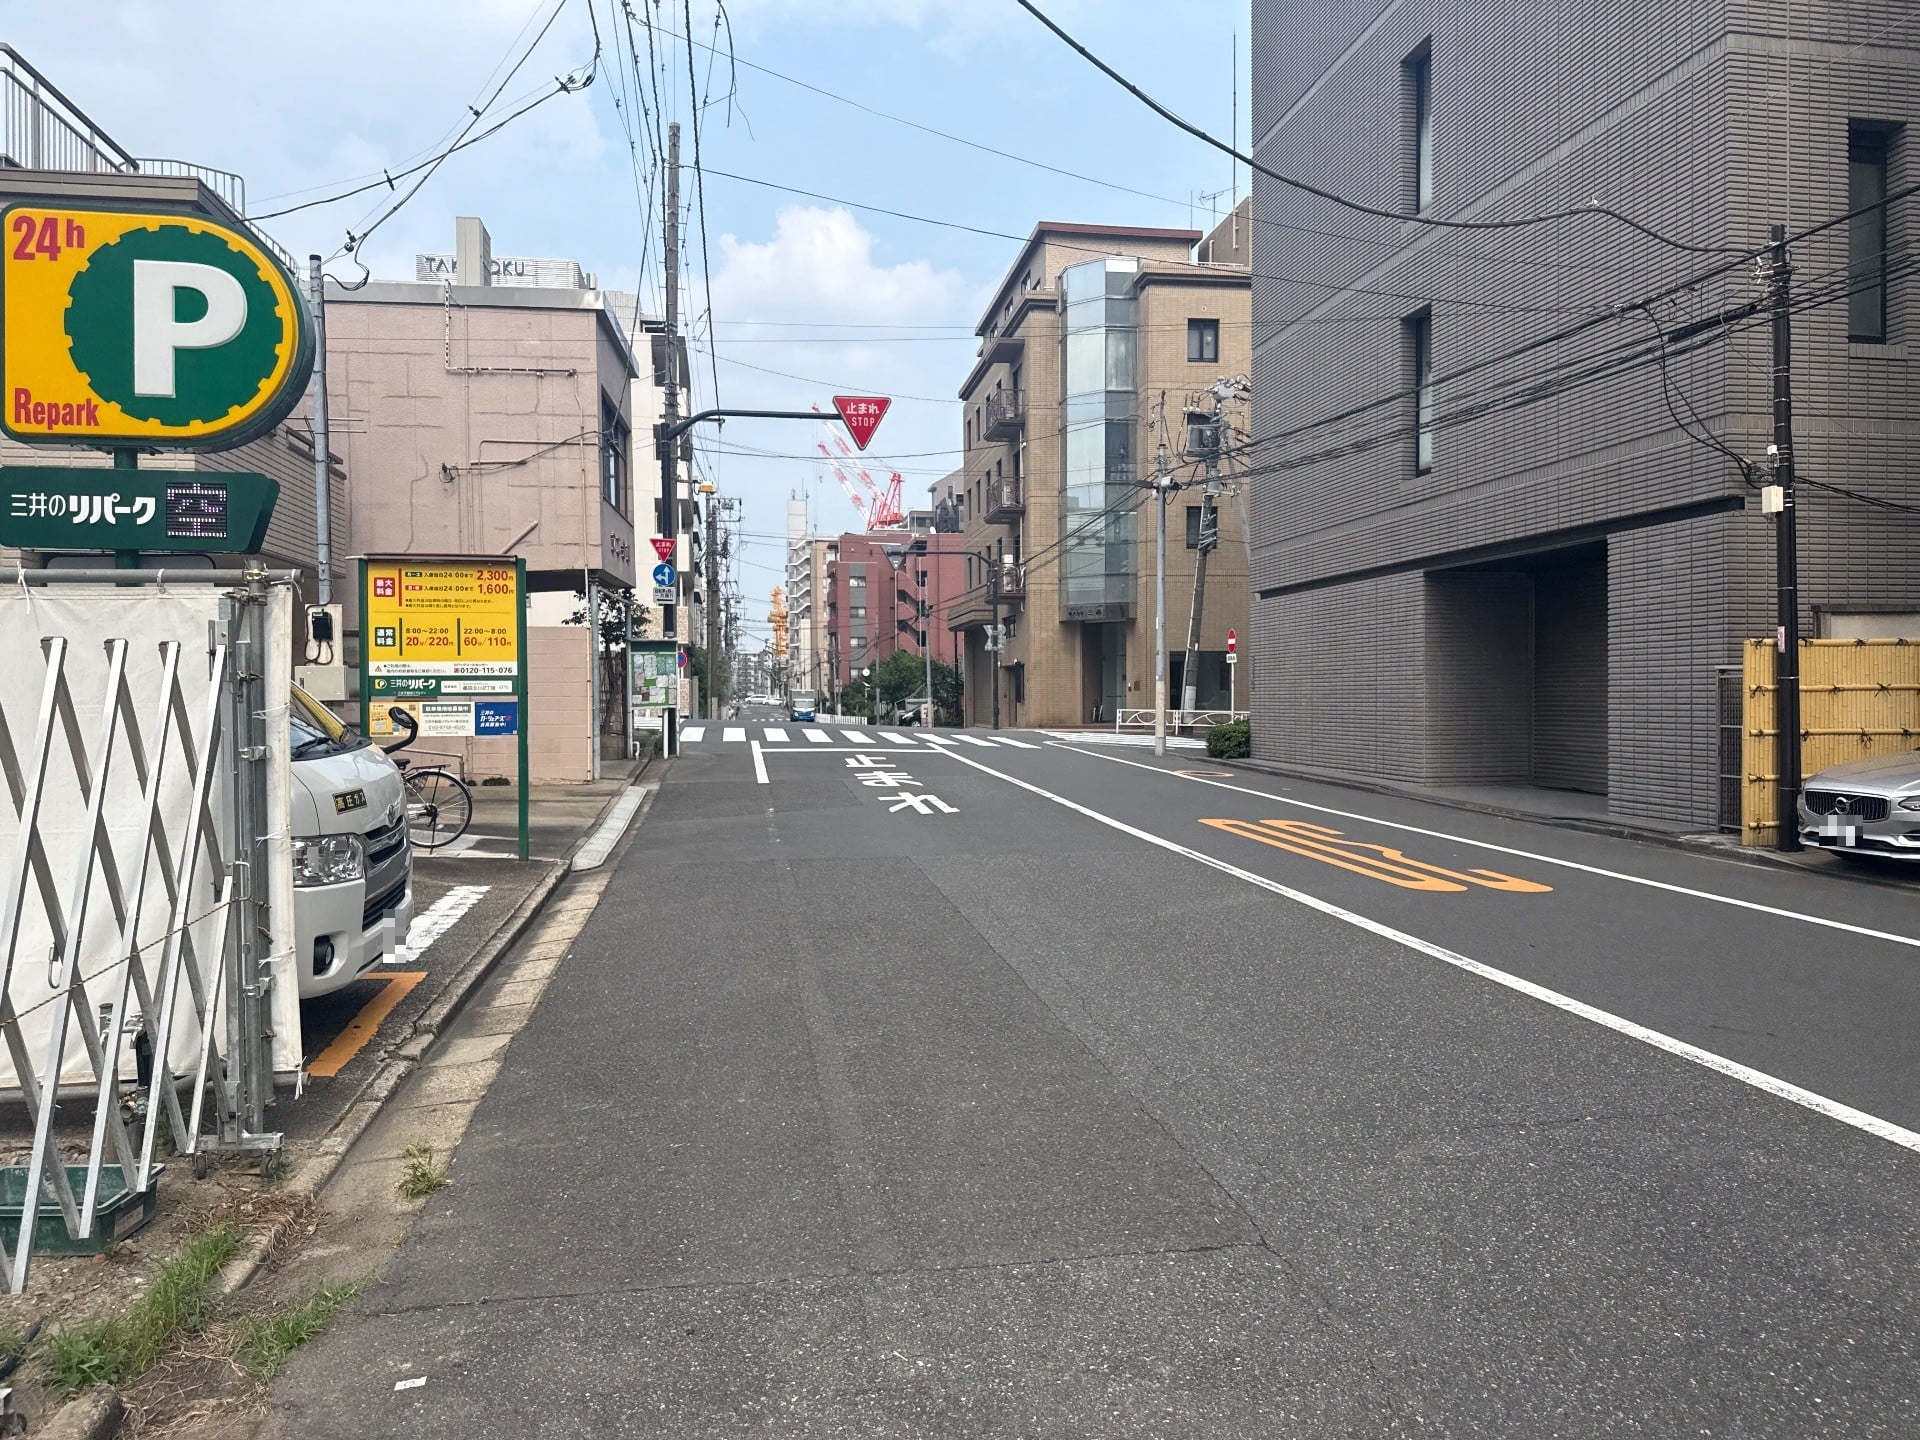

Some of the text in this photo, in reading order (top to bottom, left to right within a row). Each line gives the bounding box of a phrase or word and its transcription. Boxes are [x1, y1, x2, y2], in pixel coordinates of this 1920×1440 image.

[13, 216, 85, 261] 24h
[133, 259, 247, 398] P
[14, 388, 99, 430] Repark
[846, 402, 879, 414] 止まれ
[852, 417, 875, 426] STOP
[10, 493, 156, 525] 三井のリパーク
[390, 678, 436, 689] 三井のリパーク
